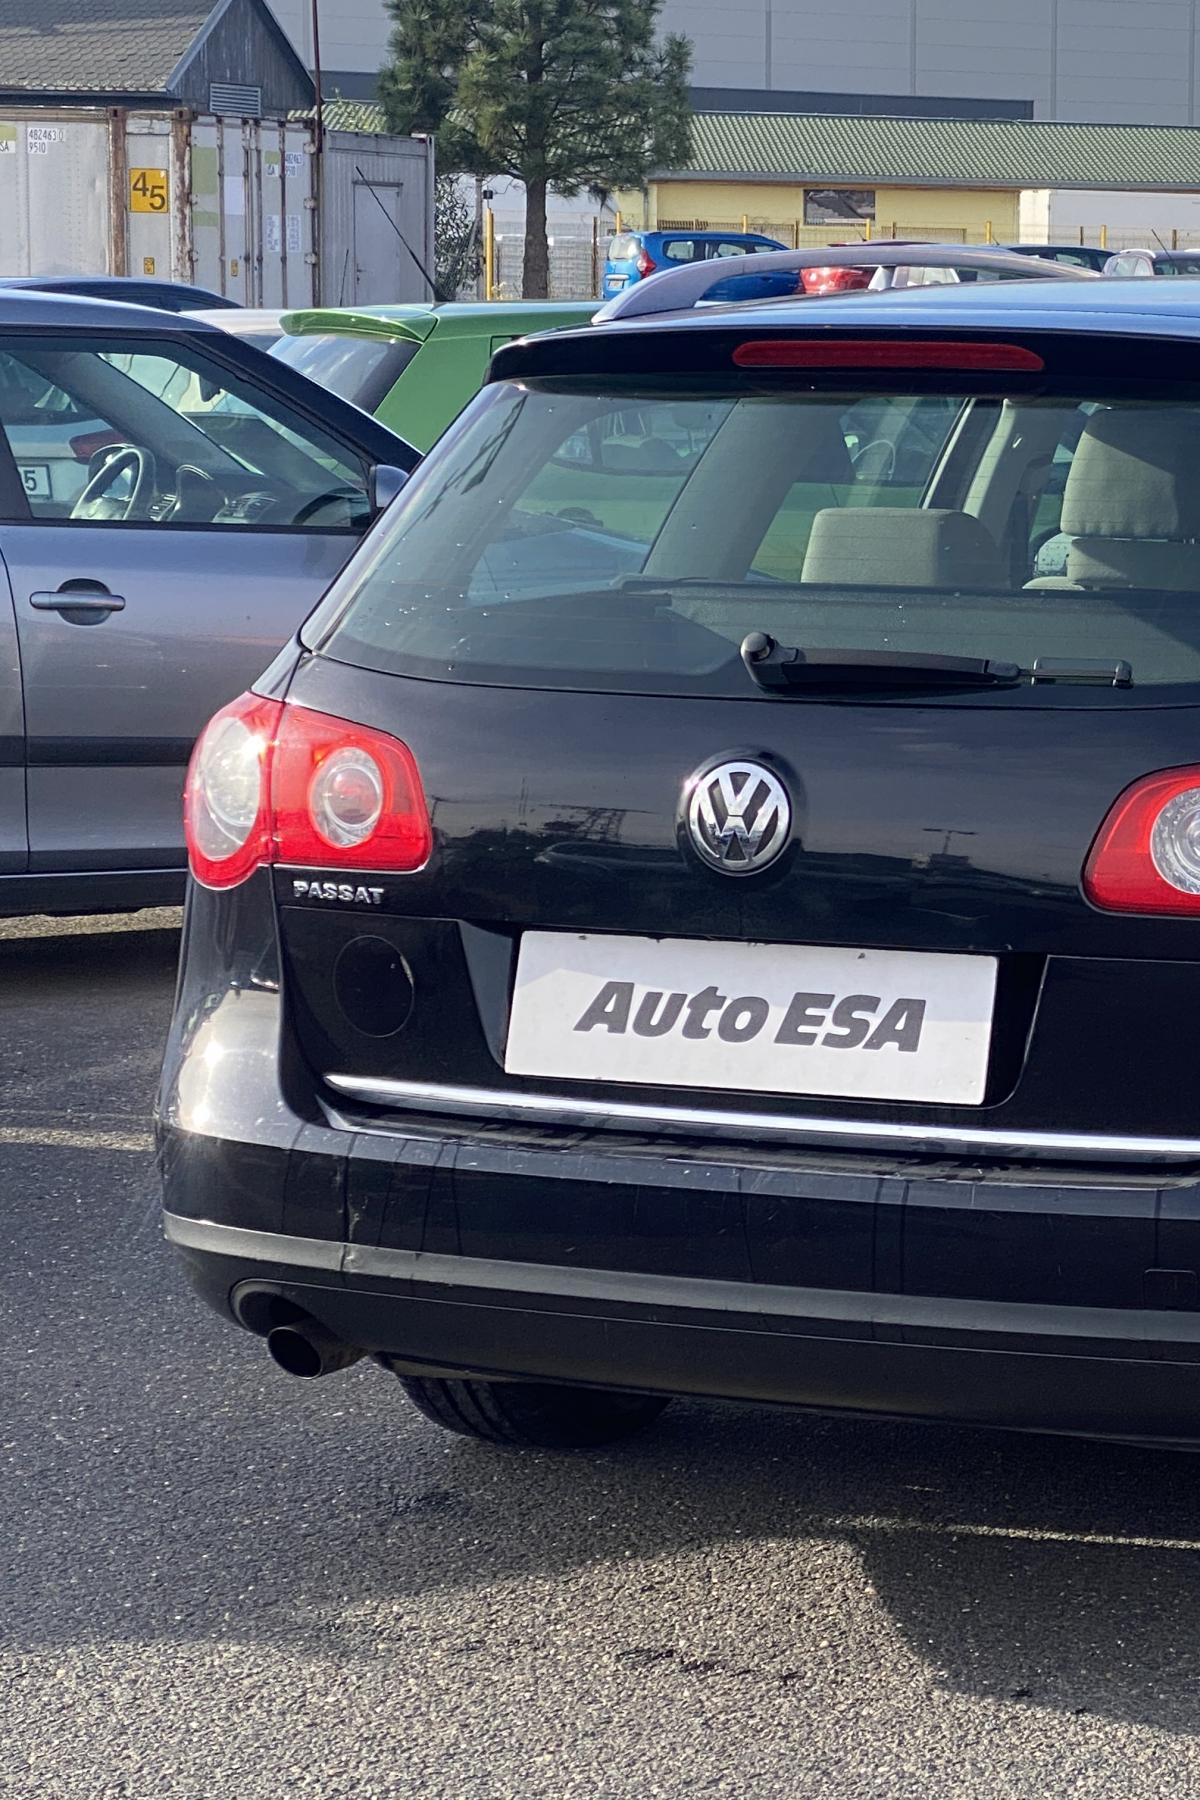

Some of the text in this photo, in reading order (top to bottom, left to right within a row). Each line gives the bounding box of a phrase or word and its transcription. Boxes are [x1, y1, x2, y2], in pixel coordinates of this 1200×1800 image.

[132, 171, 166, 211] 45
[293, 880, 385, 905] PASSAT
[573, 981, 926, 1052] Auto ESA
